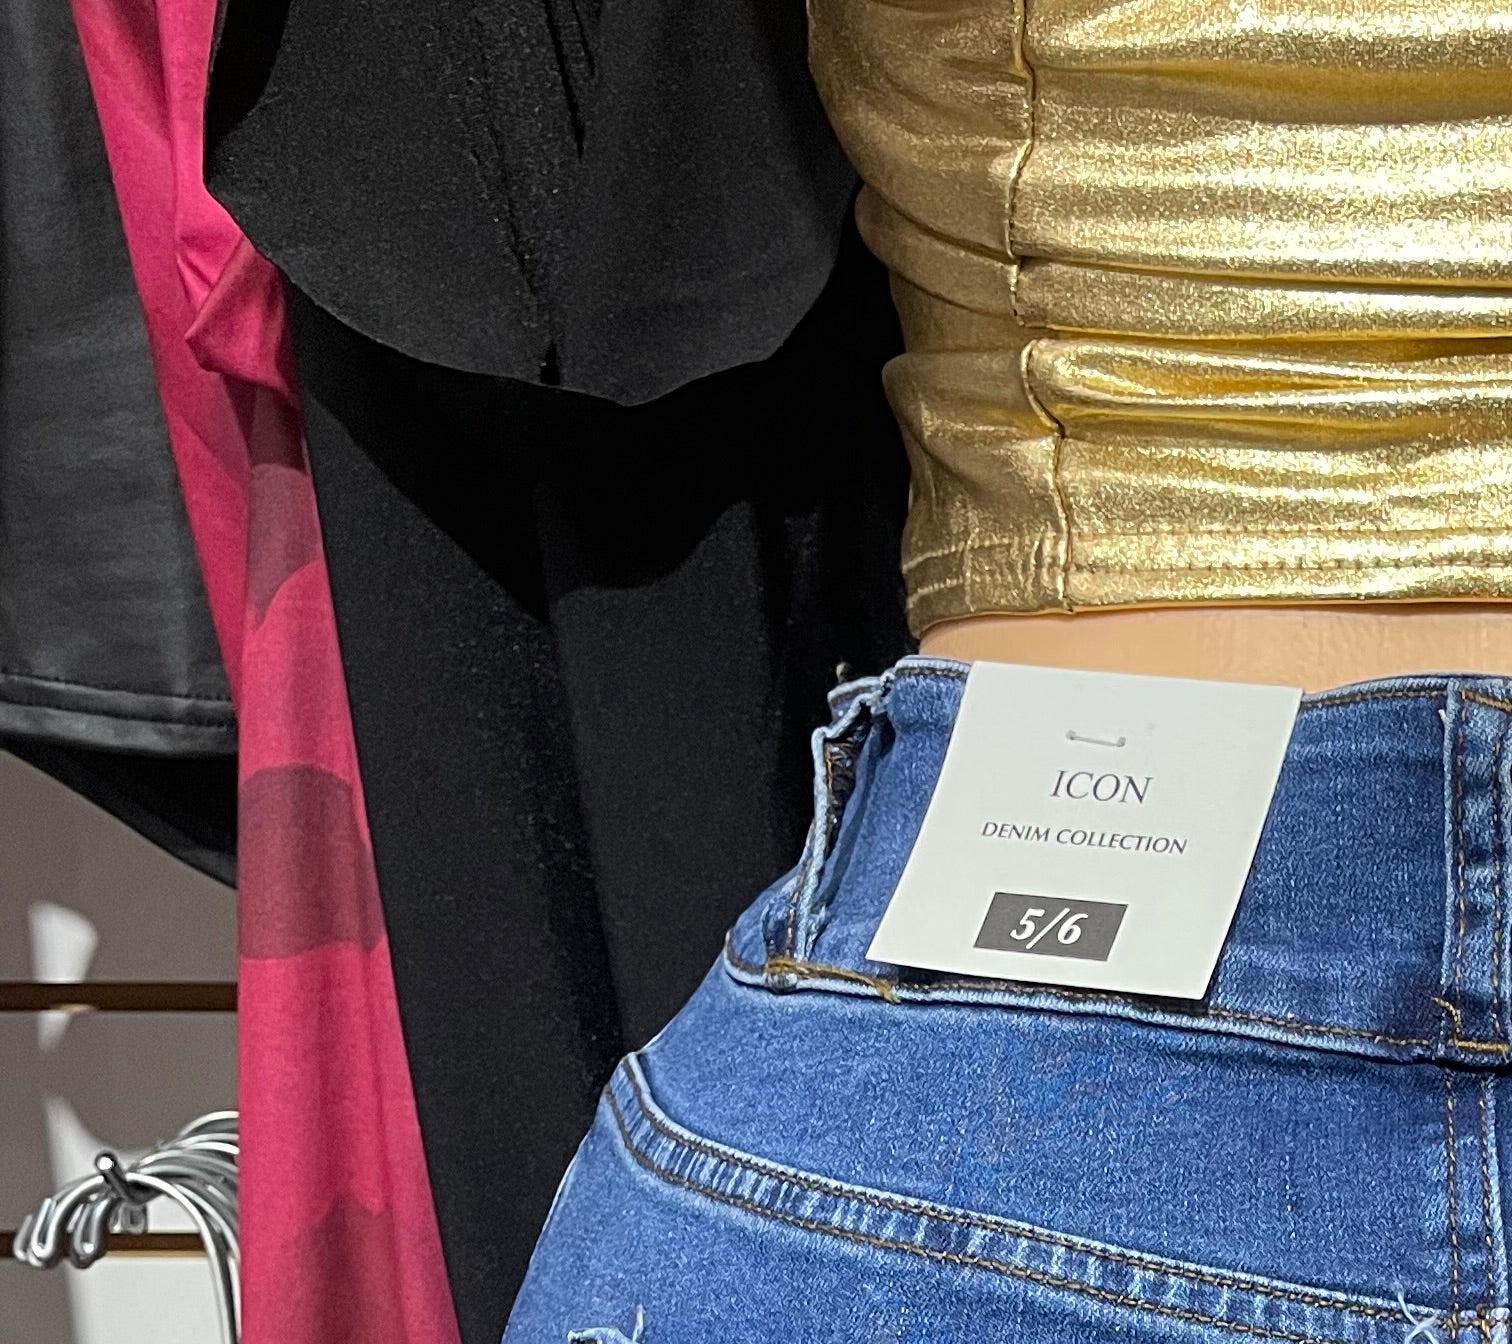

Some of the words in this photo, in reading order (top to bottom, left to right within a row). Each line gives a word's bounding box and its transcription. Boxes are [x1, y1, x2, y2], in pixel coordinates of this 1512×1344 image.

[1050, 770, 1154, 804] ICON
[981, 821, 1051, 843] DENIM
[1056, 828, 1187, 855] COLLECTION
[1009, 907, 1089, 950] 5/6
